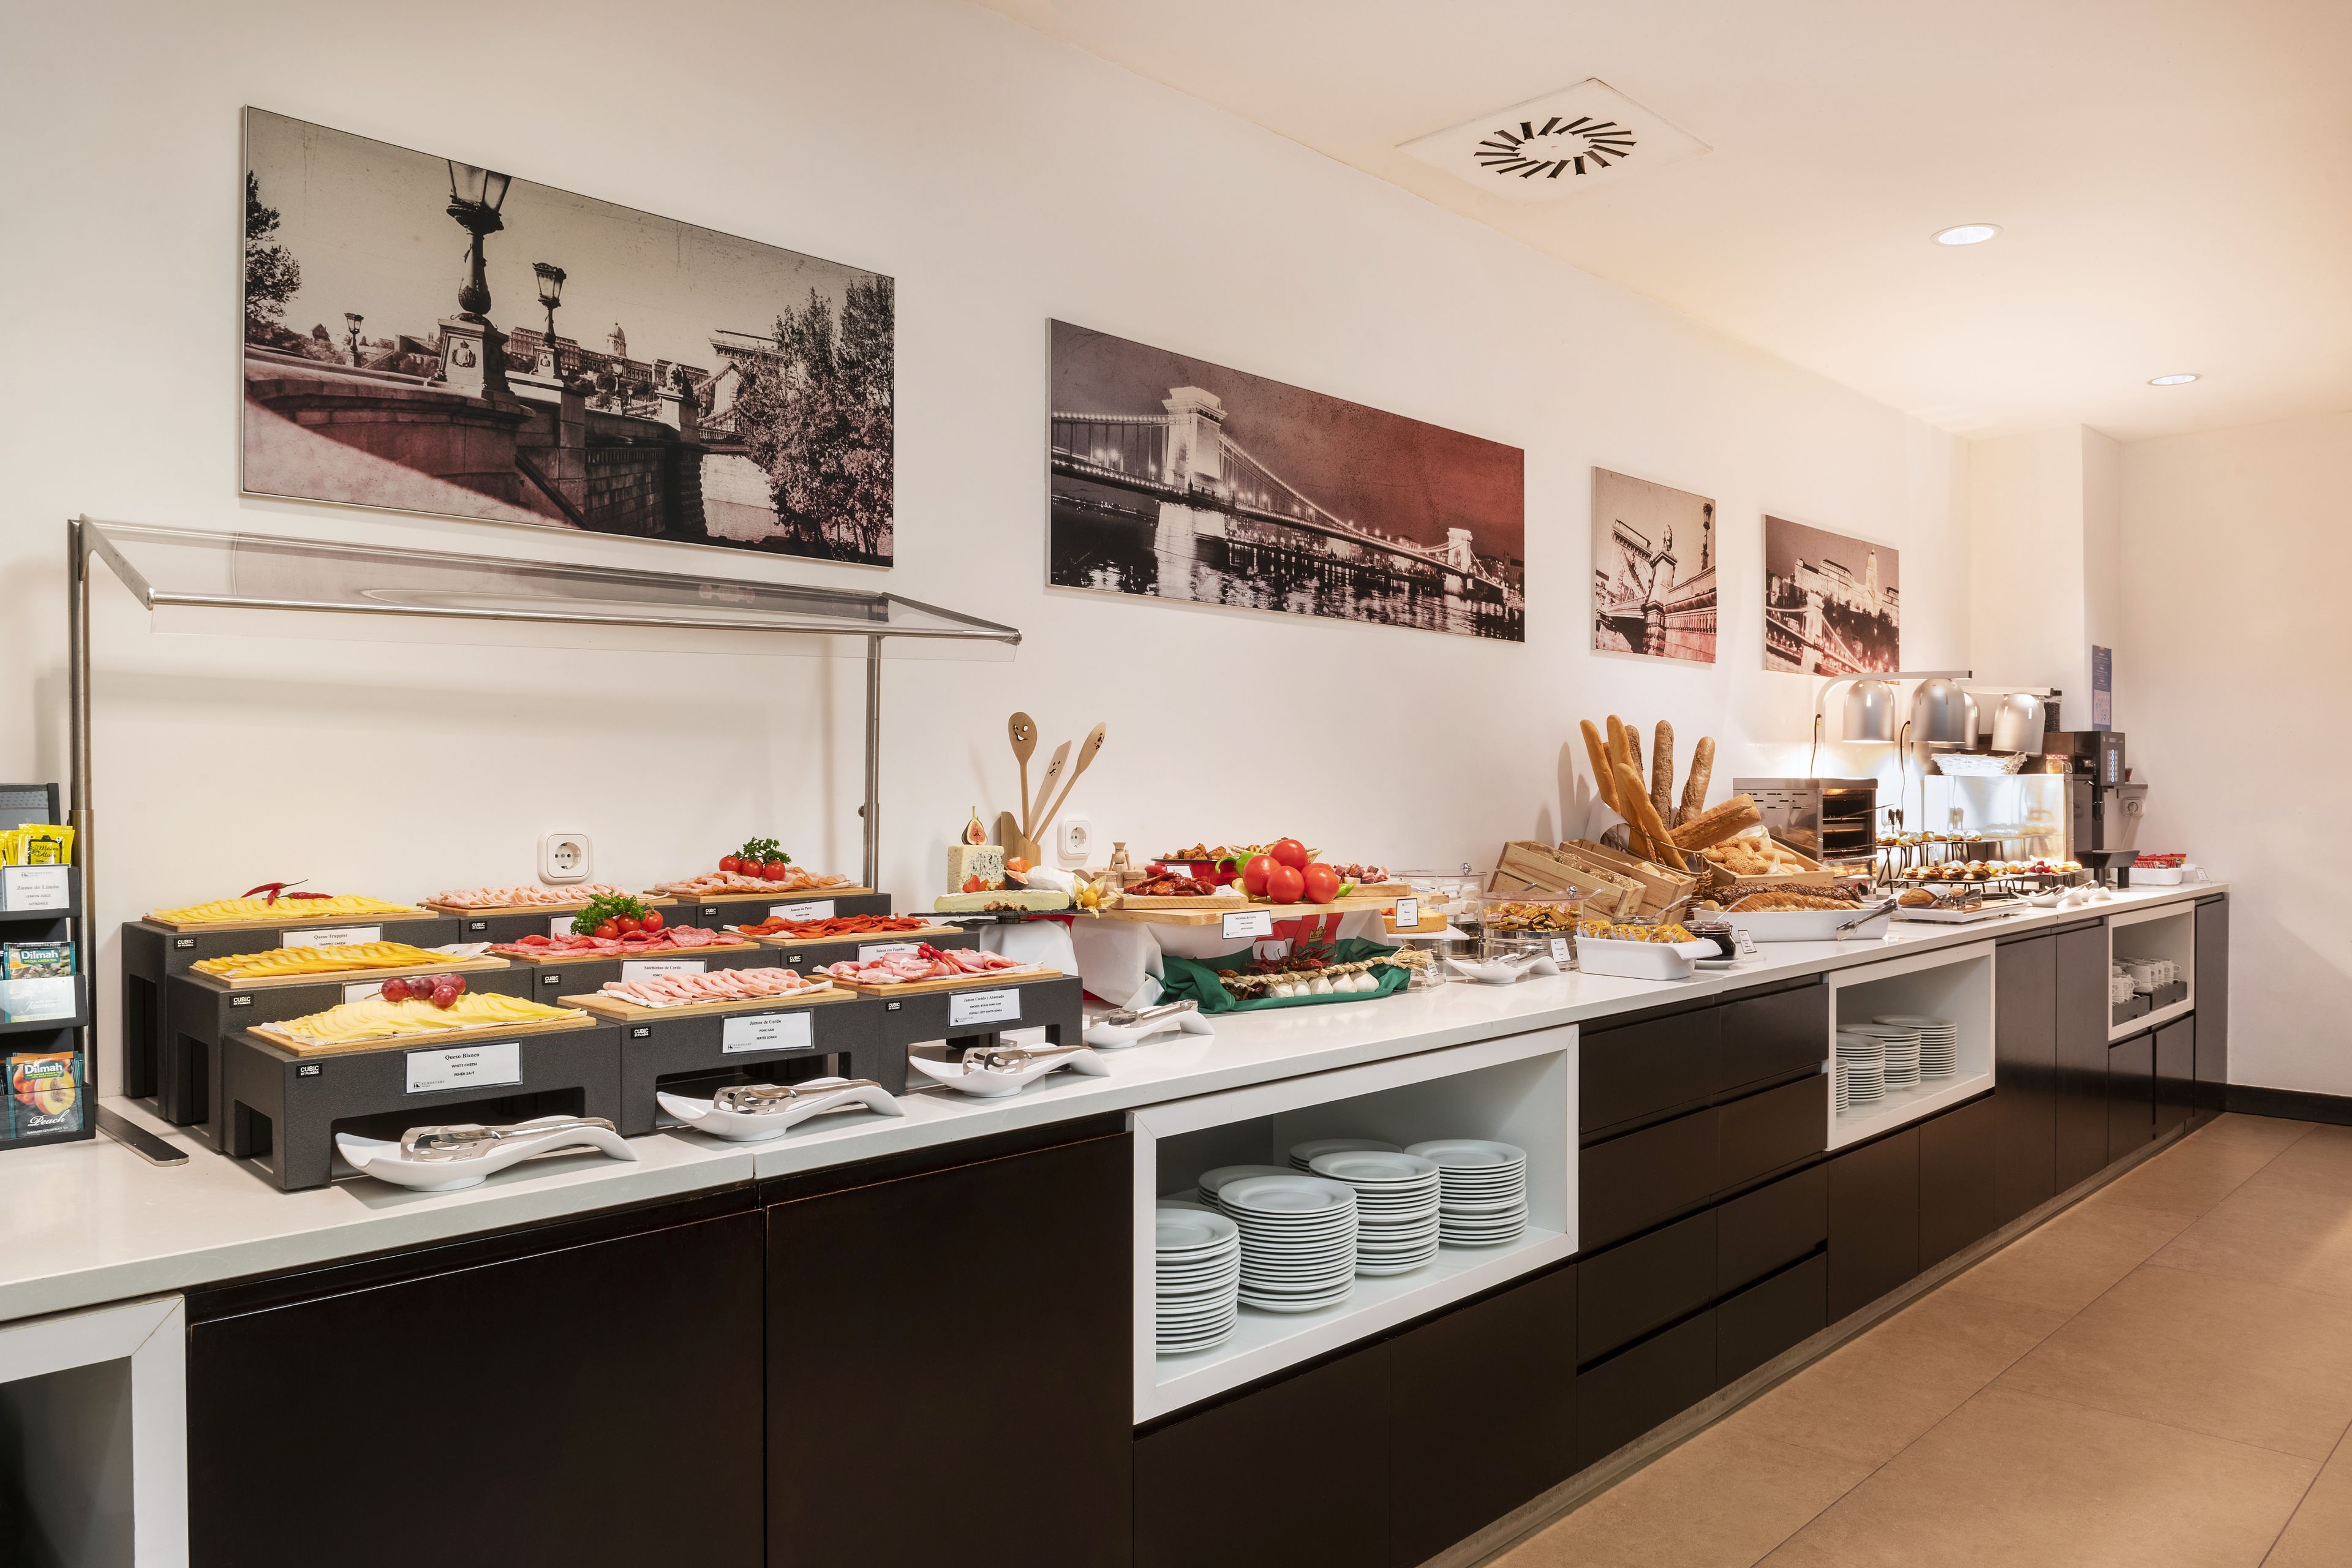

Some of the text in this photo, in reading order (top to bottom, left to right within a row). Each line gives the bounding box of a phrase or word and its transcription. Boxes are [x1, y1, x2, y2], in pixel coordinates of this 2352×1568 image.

[21, 950, 58, 959] Dilmah
[24, 1063, 62, 1074] Dilmah
[28, 1109, 70, 1126] Peach
